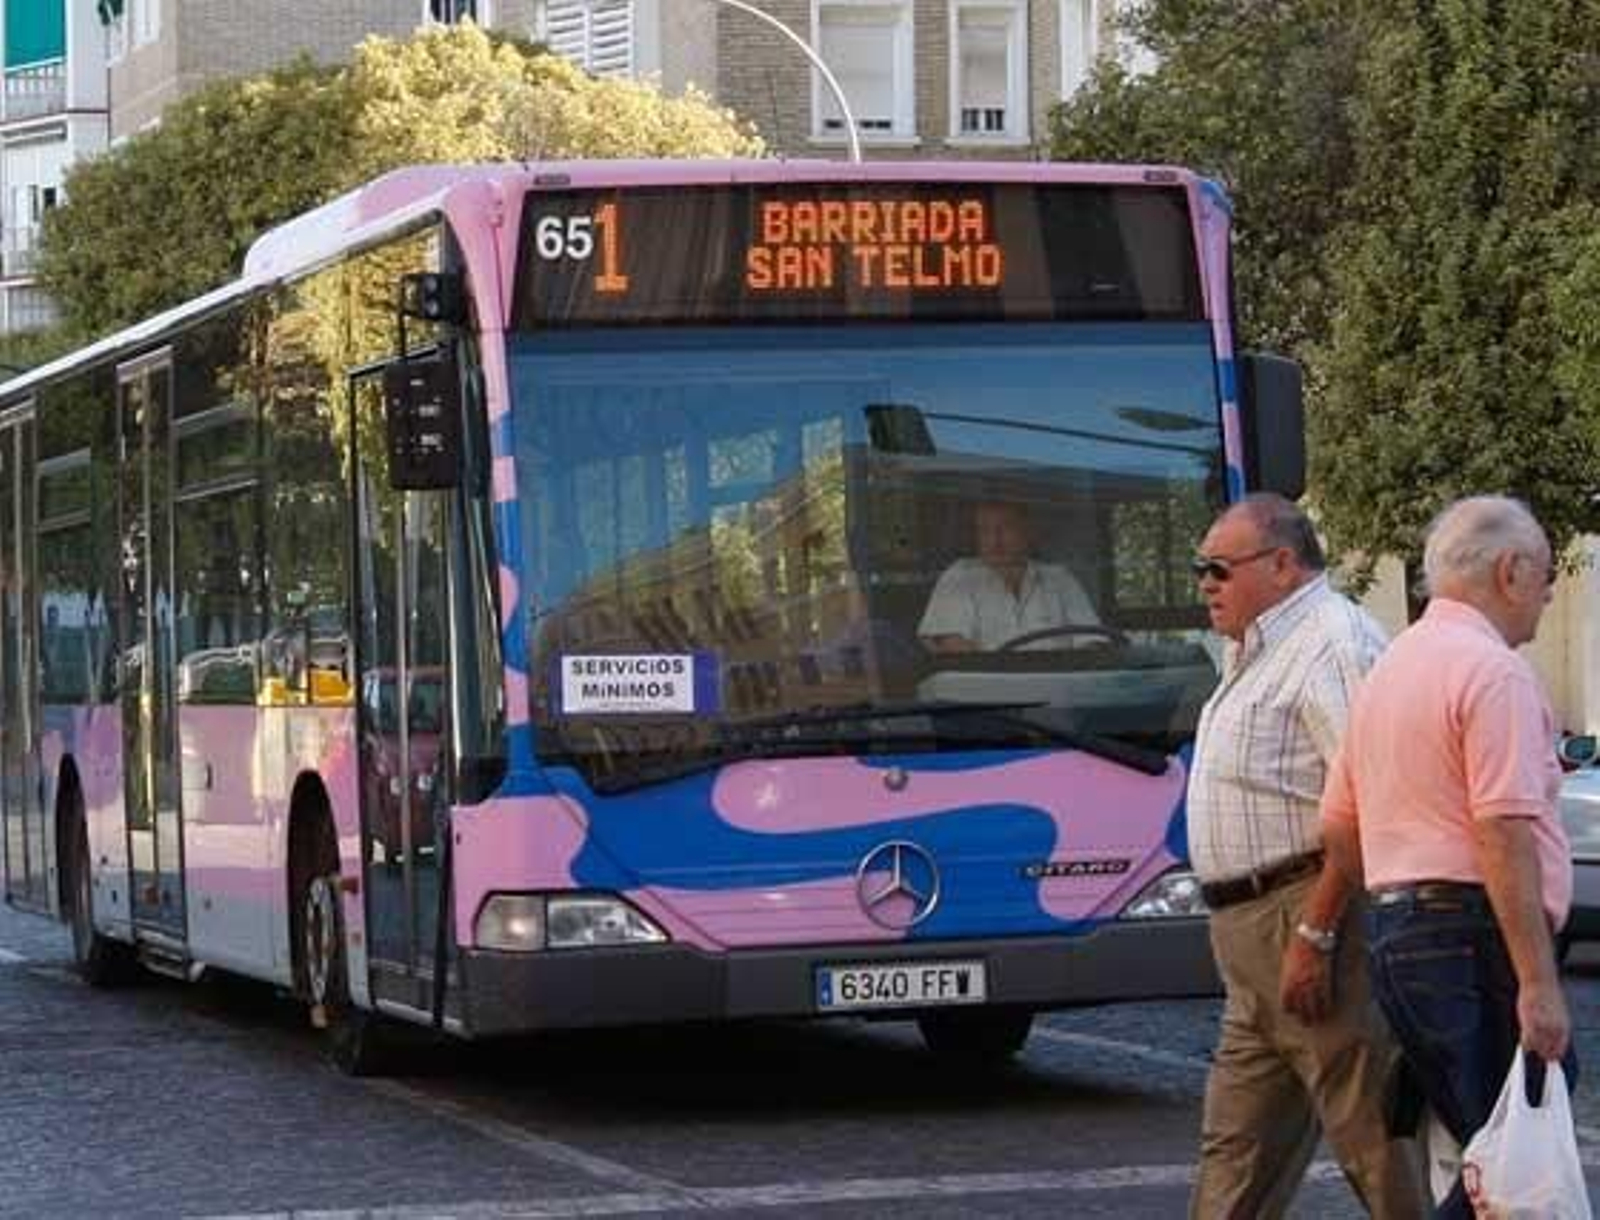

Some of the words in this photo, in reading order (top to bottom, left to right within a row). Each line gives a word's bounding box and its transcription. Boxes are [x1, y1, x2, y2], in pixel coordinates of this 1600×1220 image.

[536, 216, 594, 260] 65
[763, 201, 983, 243] BARRIADA
[593, 203, 629, 291] 1
[747, 247, 832, 289] SAN
[852, 245, 1001, 288] TELMO
[571, 658, 684, 675] SERVICIOS
[840, 972, 909, 1001] 6340
